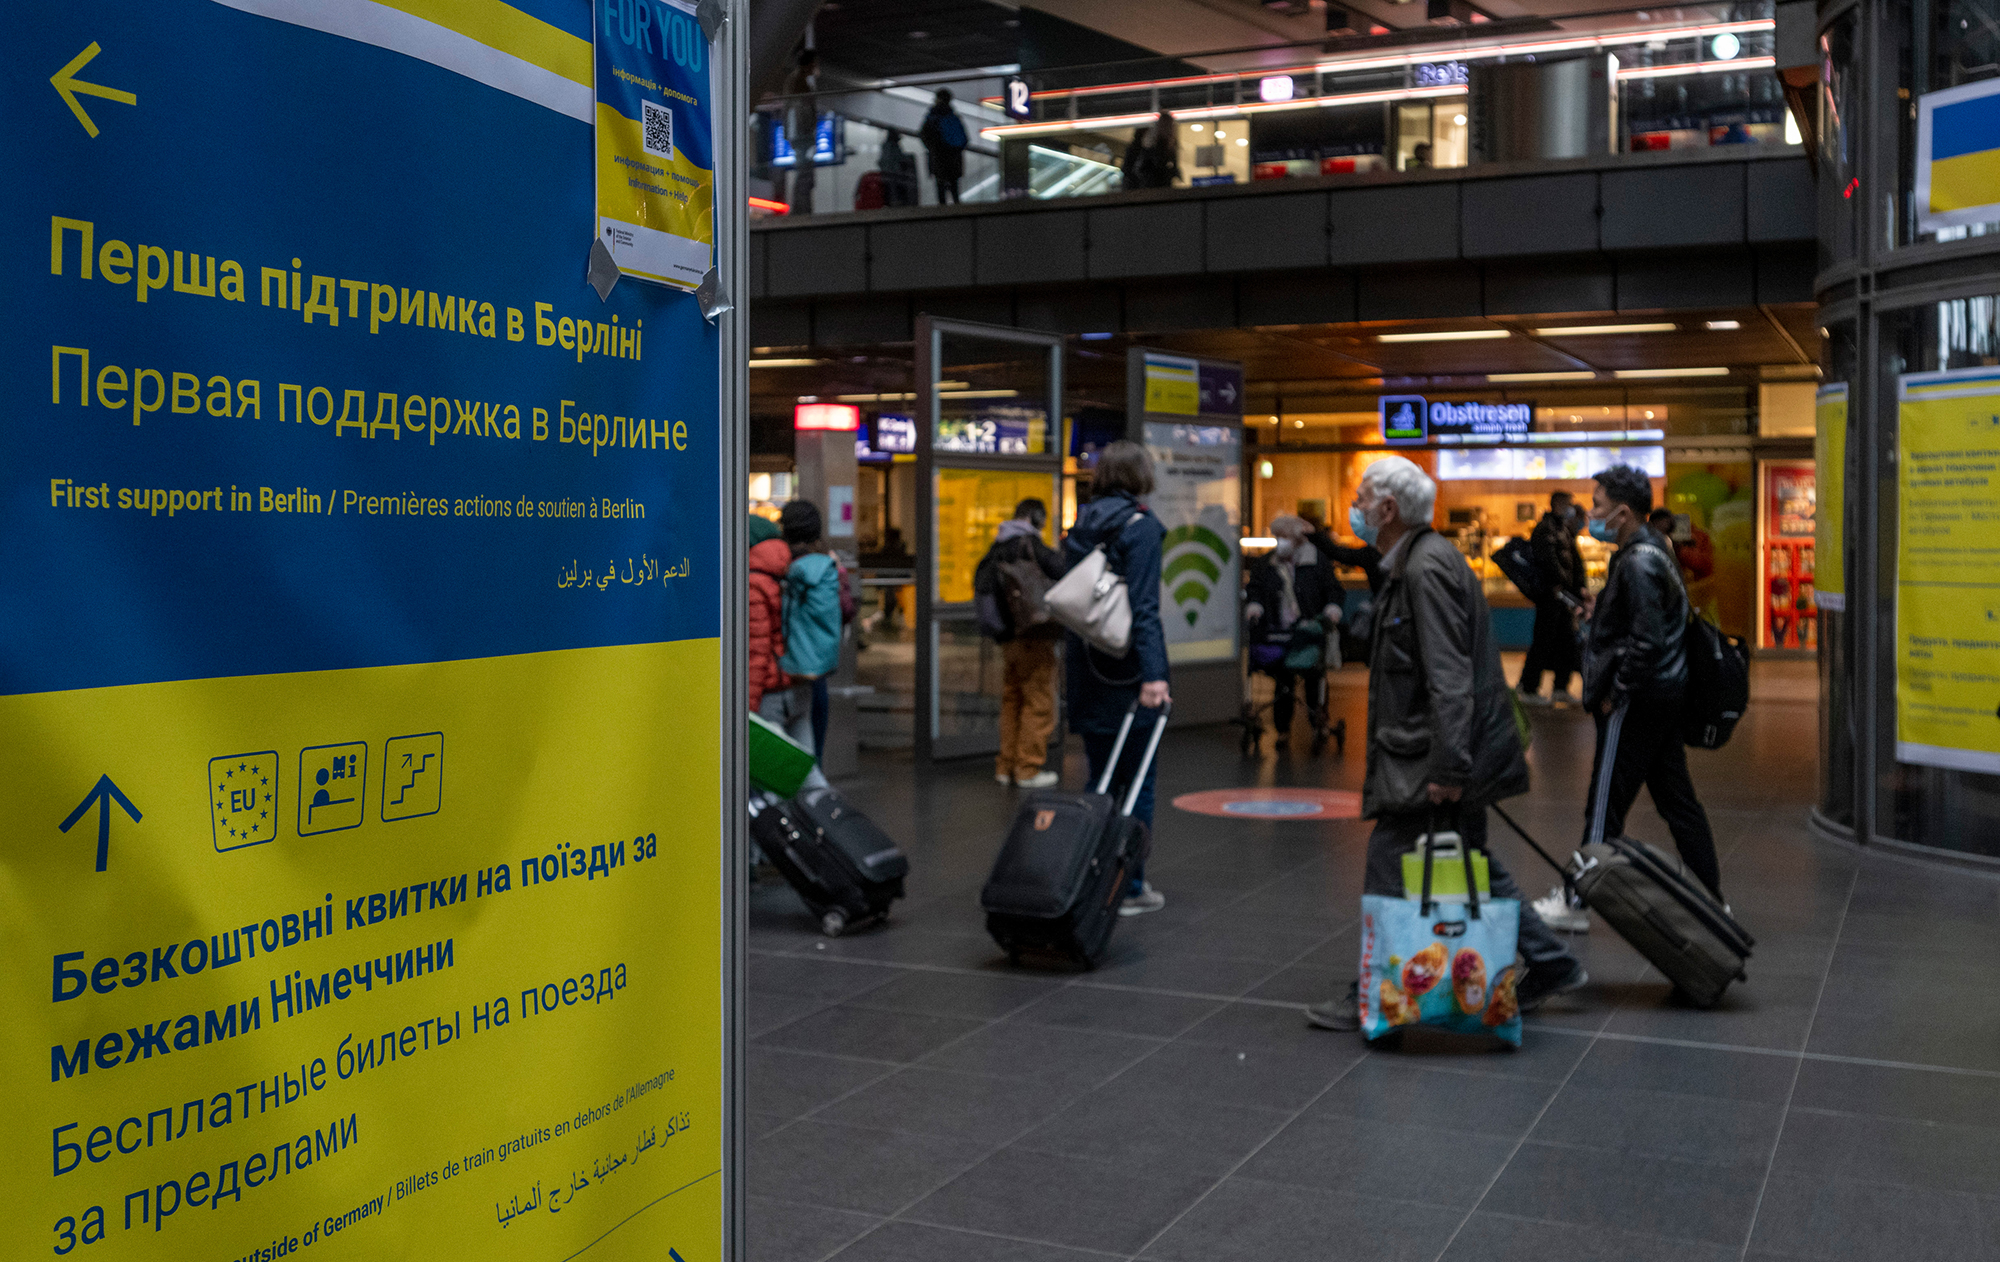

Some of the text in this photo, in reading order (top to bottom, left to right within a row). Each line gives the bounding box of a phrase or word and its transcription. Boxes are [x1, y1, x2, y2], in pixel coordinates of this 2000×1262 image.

[604, 0, 701, 73] FOR YOU
[613, 65, 656, 91] інформація
[663, 86, 698, 106] допомога
[614, 154, 664, 176] информация
[628, 177, 668, 197] Information
[674, 190, 689, 205] Help
[51, 215, 643, 363] Перша підтримка в Берліні
[52, 345, 688, 457] Первая поддержка в Берлине
[50, 478, 646, 519] First support in Berlin / Premières actions de soutien à Berlin
[557, 554, 690, 591] الدعم الأول في برلين
[231, 788, 256, 813] EU
[51, 832, 657, 1003] Безкоштовні квитки на поїзди за
[51, 938, 454, 1083] межами Німеччини
[52, 962, 627, 1177] Бесплатные билеты на поезда
[52, 1113, 358, 1256] за пределами
[233, 1068, 675, 1262] tside of Germany / Billets de train gratuits en dehors de l'Allemagne
[495, 1110, 691, 1228] تذاكر قطار مجانية خارج ألمانيا
